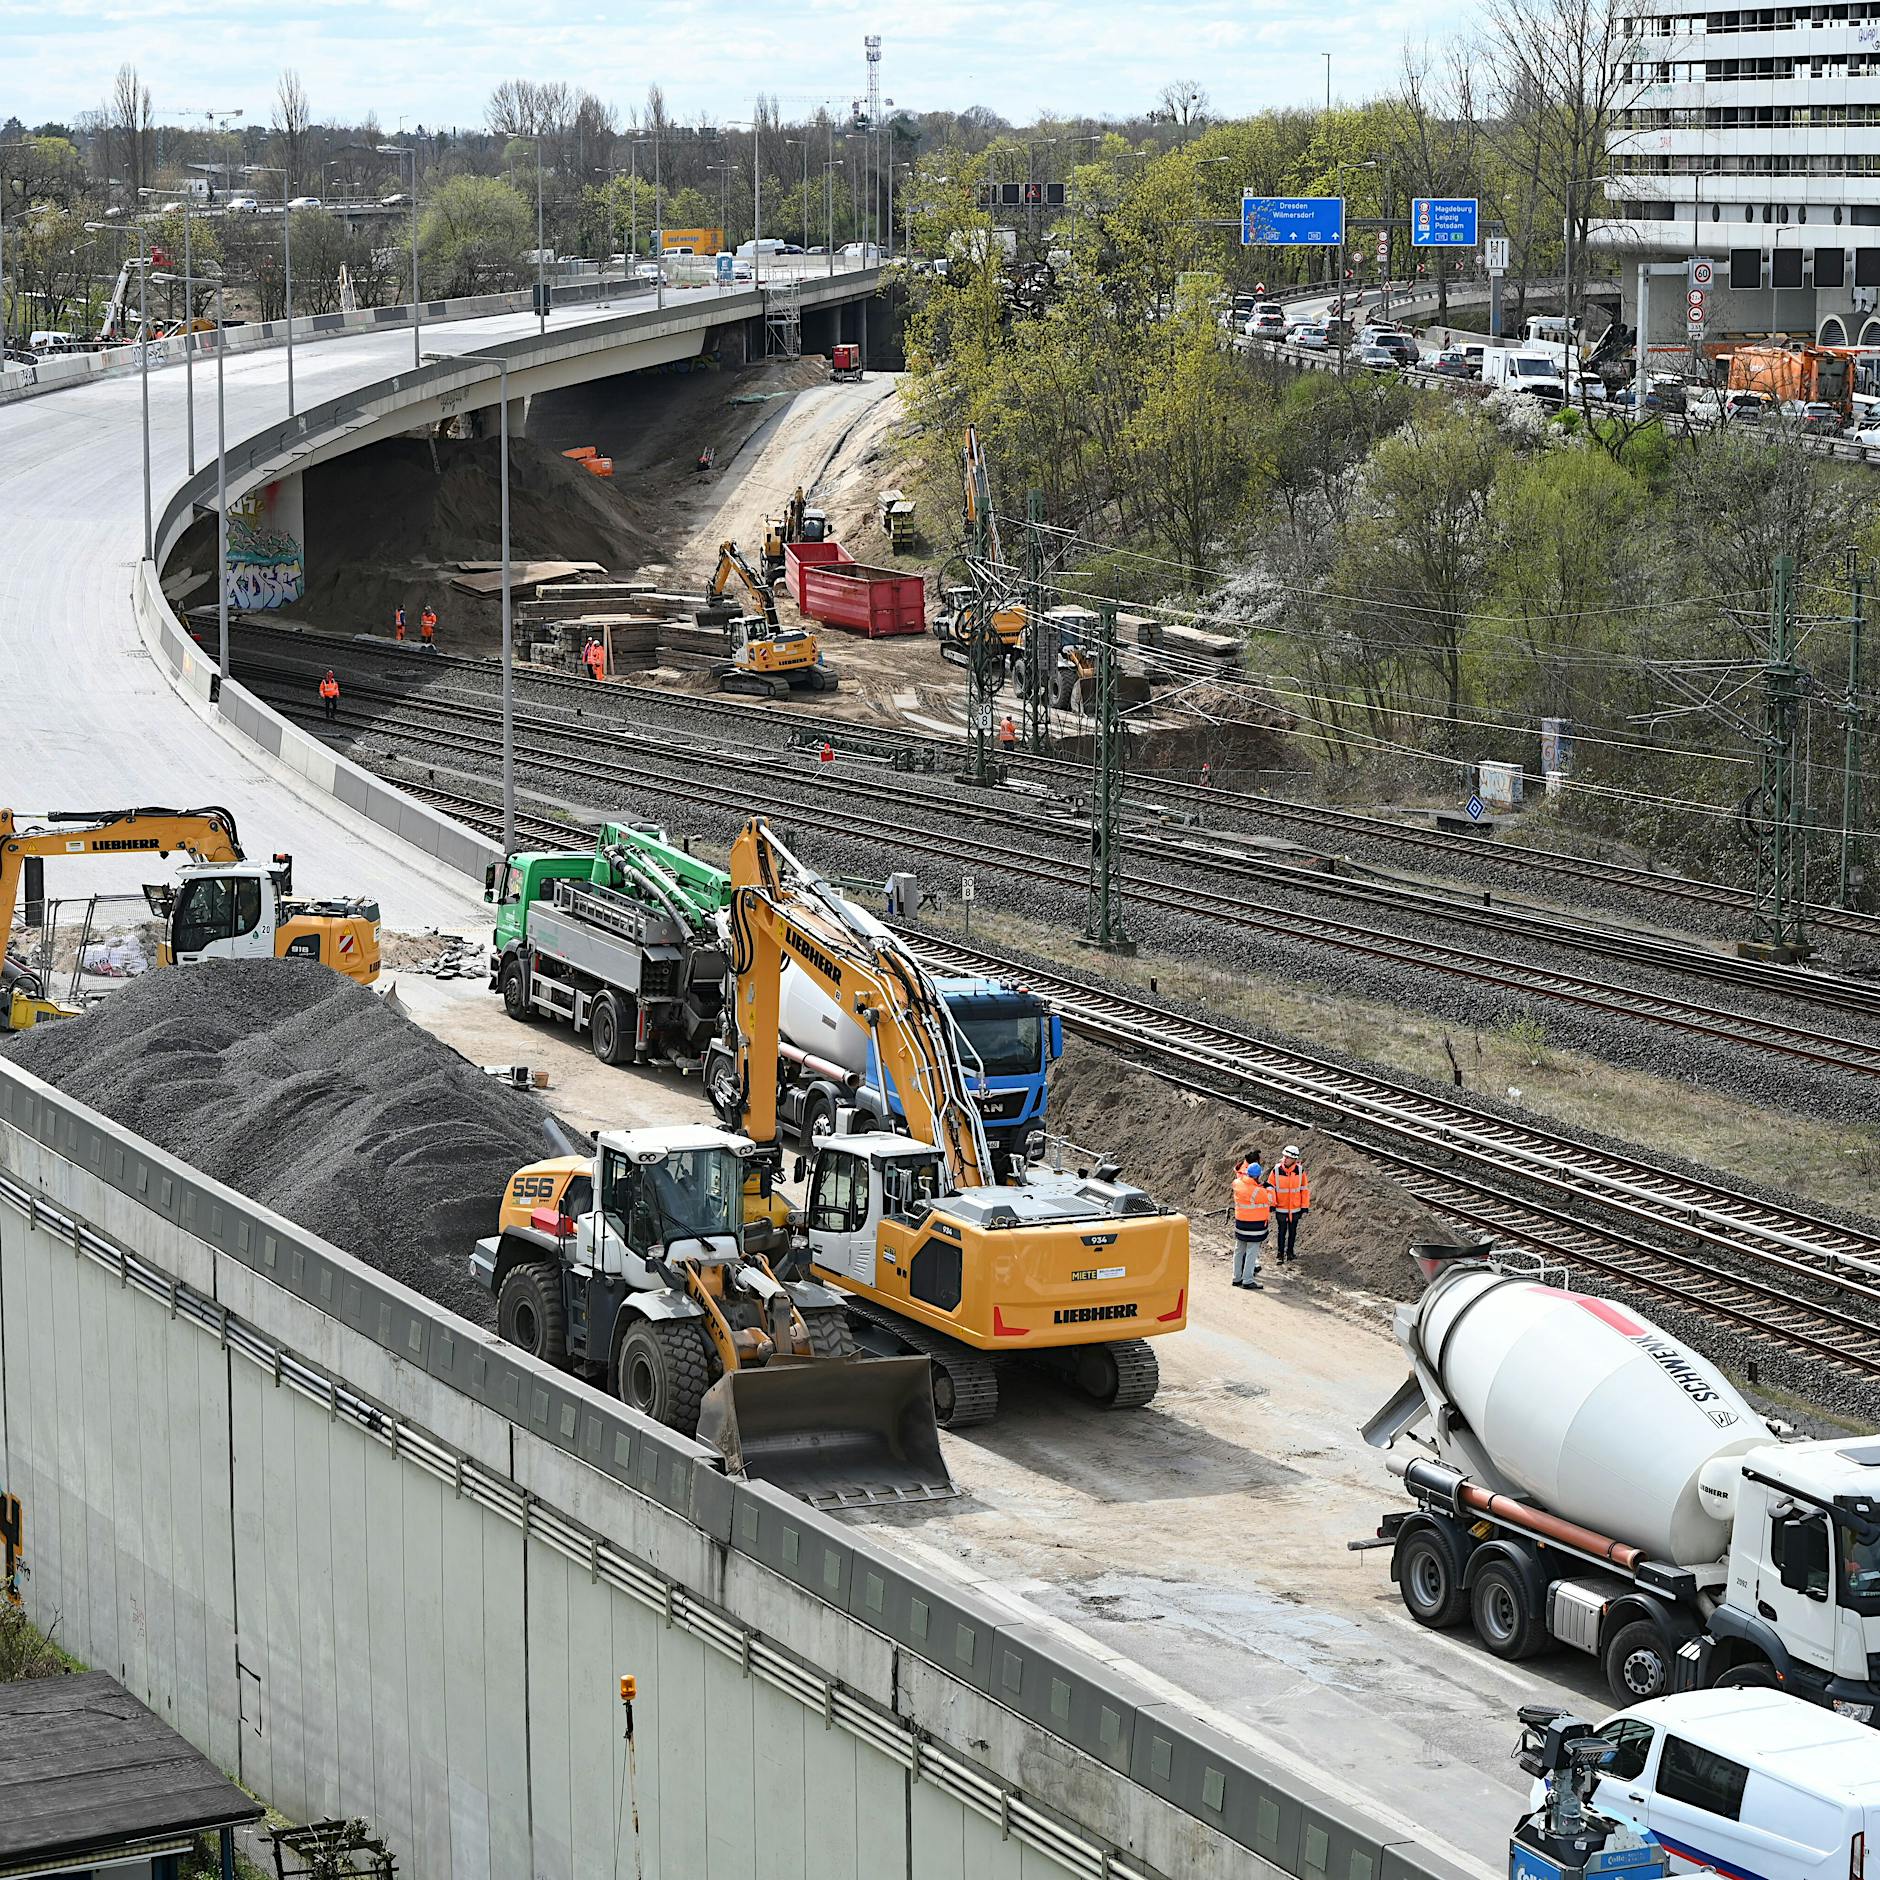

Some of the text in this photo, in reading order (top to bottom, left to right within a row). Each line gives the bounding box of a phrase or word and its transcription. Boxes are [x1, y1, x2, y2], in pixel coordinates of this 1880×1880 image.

[1435, 205, 1472, 213] Magdeburg
[1697, 269, 1708, 278] 60
[978, 704, 991, 715] 30
[982, 715, 988, 726] 8
[92, 839, 160, 850] LIEBHERR
[963, 878, 973, 887] 30
[965, 888, 971, 897] 8
[262, 925, 271, 934] 20
[291, 945, 309, 953] 918
[785, 926, 842, 987] LIEBHERR
[983, 1103, 1004, 1113] AN
[512, 1177, 555, 1198] 556
[942, 1225, 953, 1236] 934
[1091, 1236, 1108, 1245] 934
[1072, 1270, 1097, 1281] MIETE
[1053, 1303, 1138, 1324] LIEBHERR
[1629, 1334, 1720, 1402] SCHWENK
